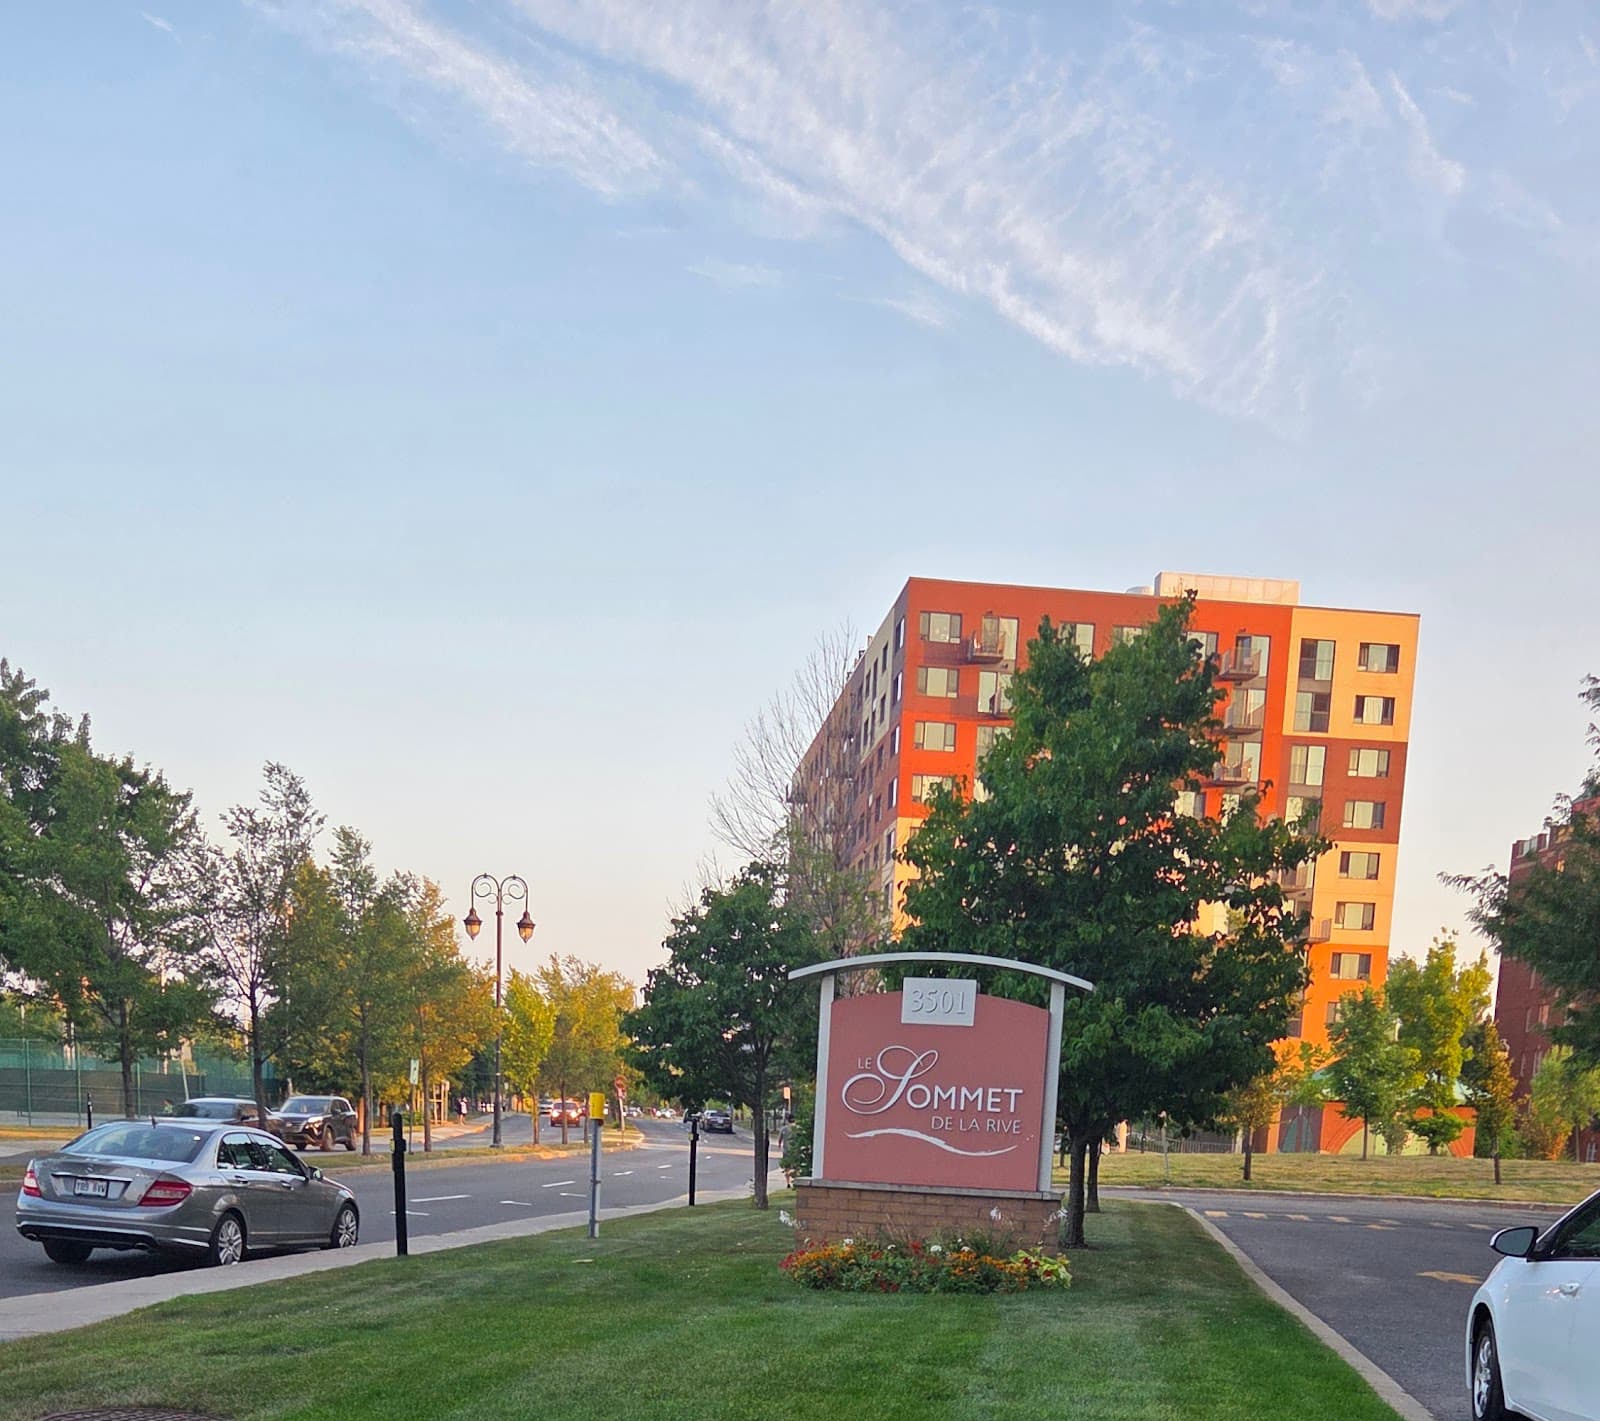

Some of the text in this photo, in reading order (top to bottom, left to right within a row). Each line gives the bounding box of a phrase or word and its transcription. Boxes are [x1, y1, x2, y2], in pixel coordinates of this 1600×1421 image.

[911, 989, 967, 1015] 3501
[842, 1045, 1023, 1115] LE SOMMET
[931, 1116, 1021, 1135] DE LA RIVE
